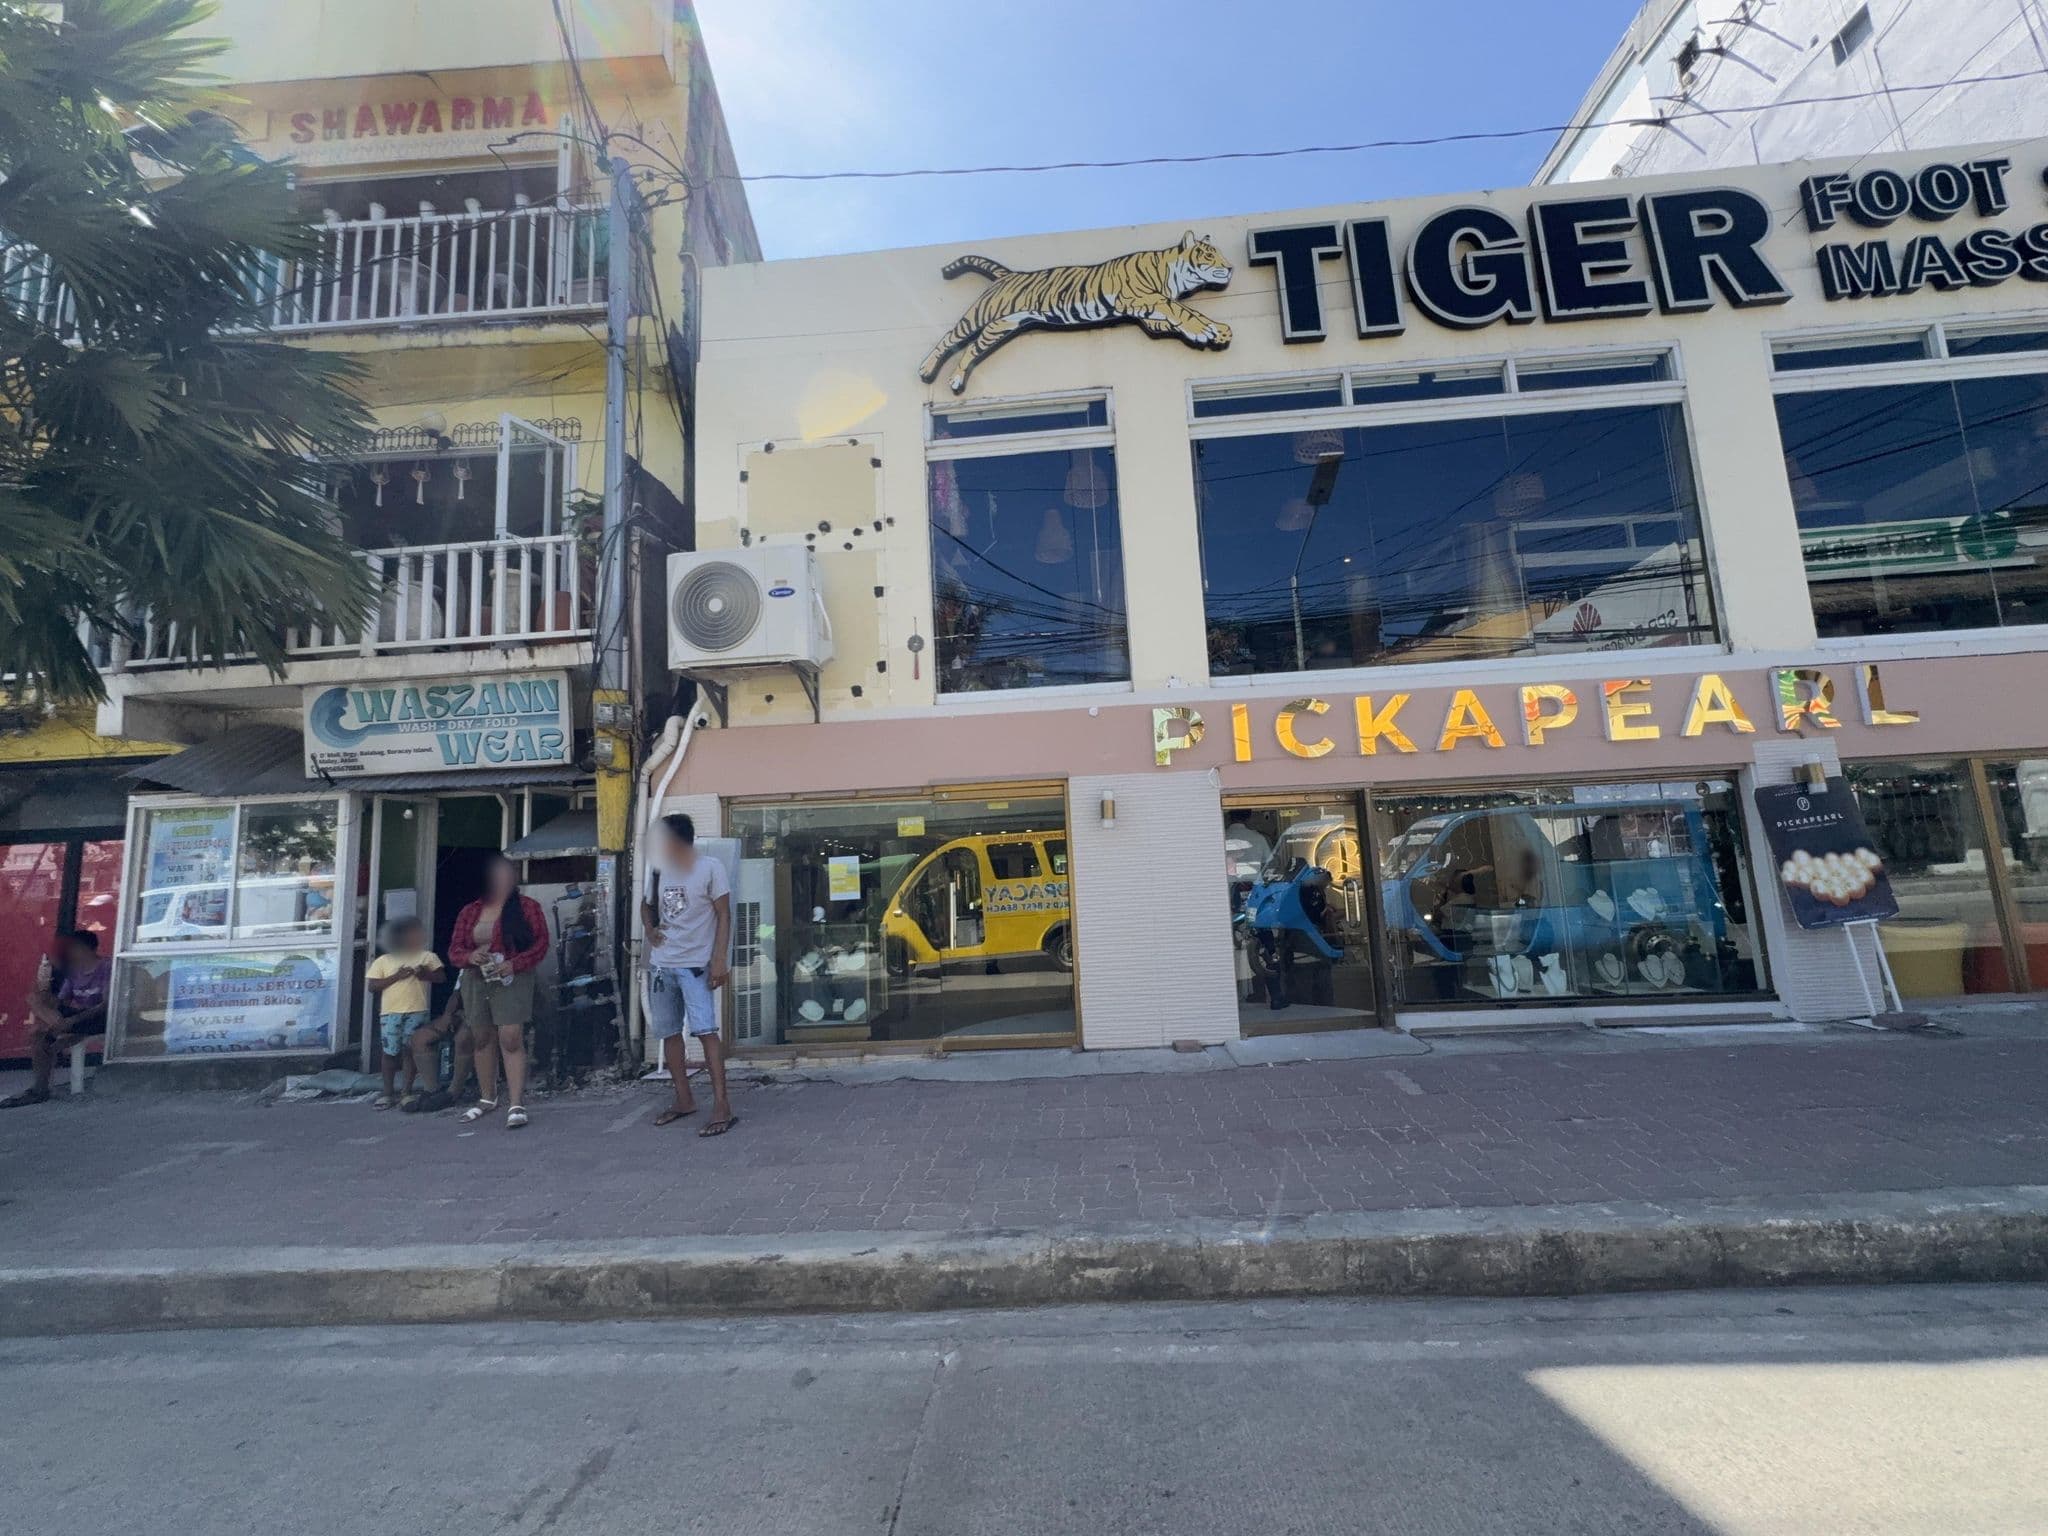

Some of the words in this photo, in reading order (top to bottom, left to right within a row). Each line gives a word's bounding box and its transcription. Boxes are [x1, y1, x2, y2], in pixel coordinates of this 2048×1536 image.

[290, 90, 547, 143] SHAWARMA
[1799, 157, 2014, 234] FOOT
[1246, 185, 1794, 345] TIGER
[351, 679, 559, 723] WASZANN
[399, 721, 436, 733] WASH
[449, 719, 474, 730] DRY
[485, 717, 519, 728] FOLD
[1152, 664, 1921, 767] PICKAPEARL
[436, 727, 565, 765] WEAR
[1776, 811, 1845, 828] PICKAPEARL
[212, 981, 251, 994] FULL
[256, 978, 327, 992] SERVICE
[199, 996, 260, 1008] Maximum
[264, 994, 302, 1006] 8kilos
[191, 1014, 245, 1025] WASH
[190, 1030, 229, 1040] DRY
